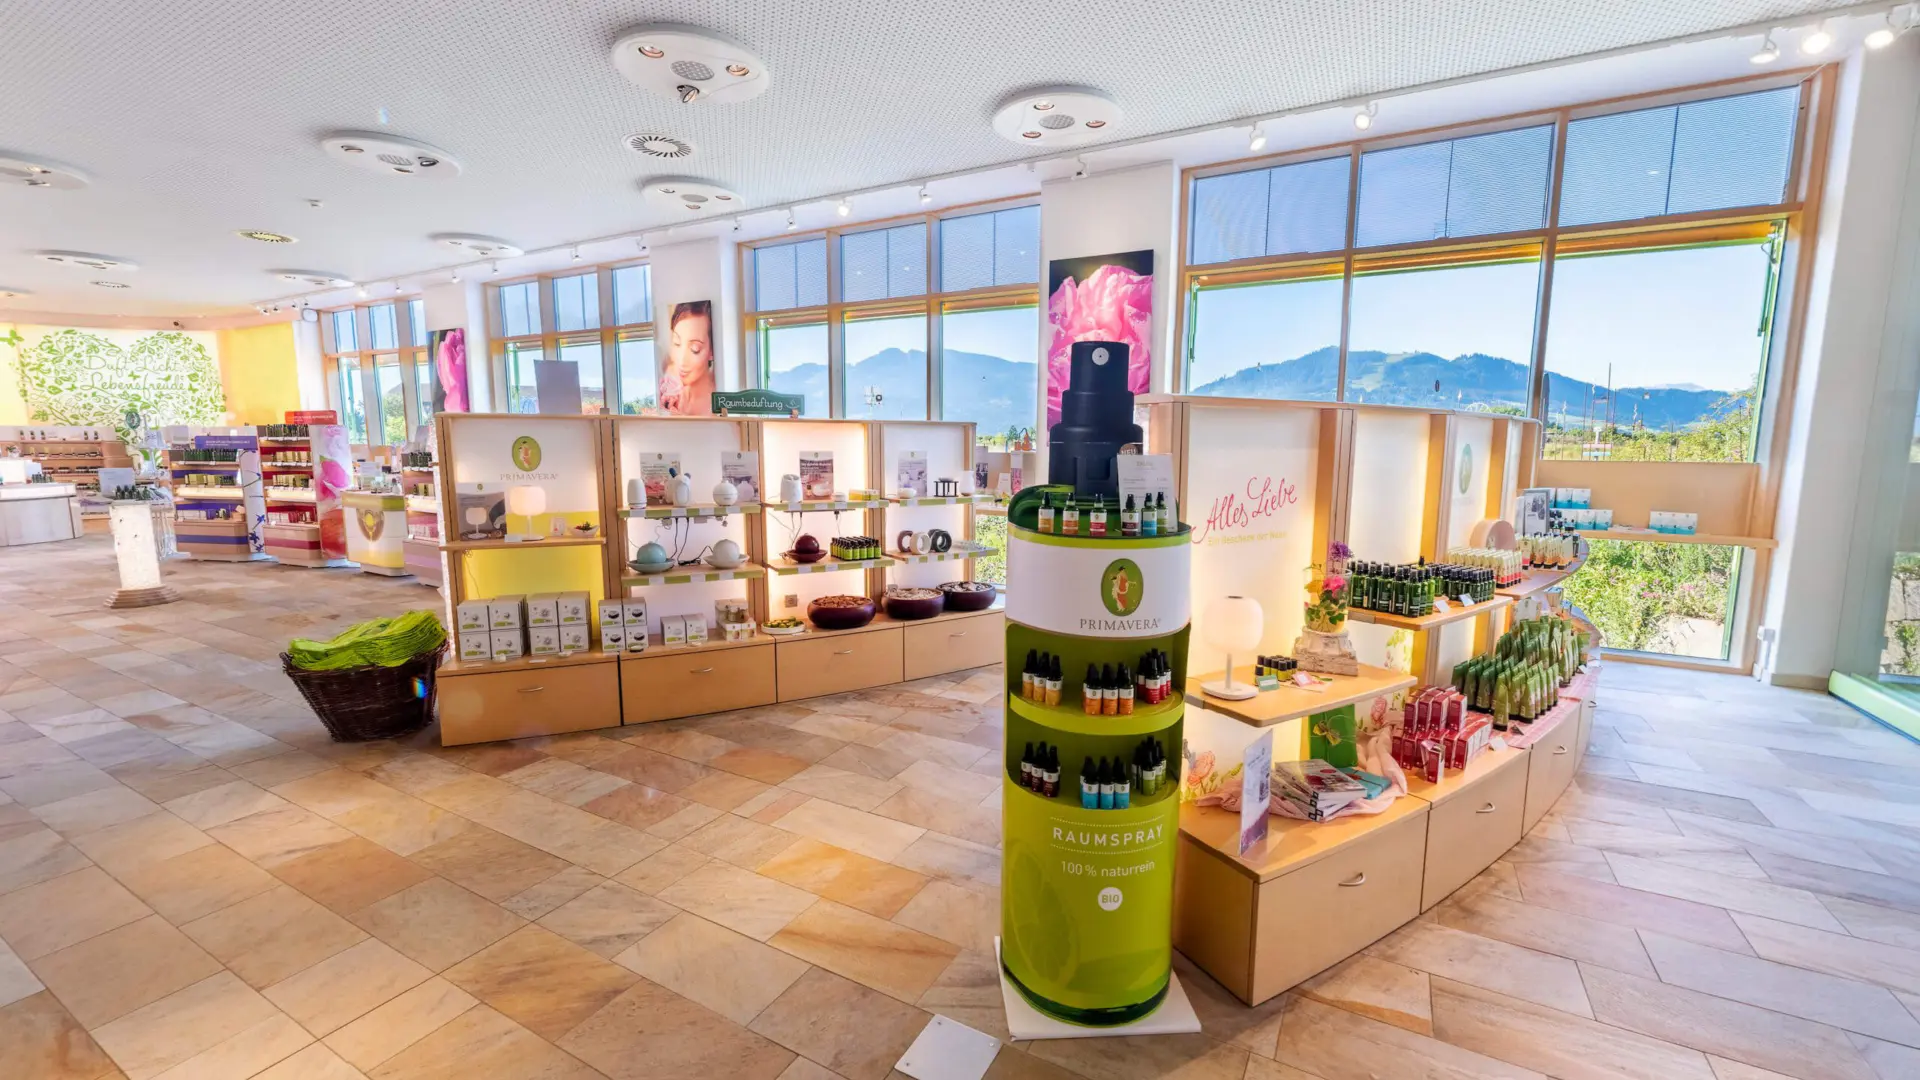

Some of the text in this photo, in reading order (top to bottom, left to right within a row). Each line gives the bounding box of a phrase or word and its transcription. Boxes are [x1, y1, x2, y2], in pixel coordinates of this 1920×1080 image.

[83, 355, 135, 378] Duft
[80, 371, 186, 400] Lebensfreude
[717, 396, 783, 410] Raumbeduftung
[500, 473, 559, 481] PRIMAVERA
[1190, 476, 1298, 544] Alles Liebe
[1080, 618, 1161, 631] PRIMAVERA
[1053, 824, 1163, 847] RAUMSPRAY
[1061, 860, 1155, 877] 100 % naturrein
[1101, 894, 1120, 904] BIO
